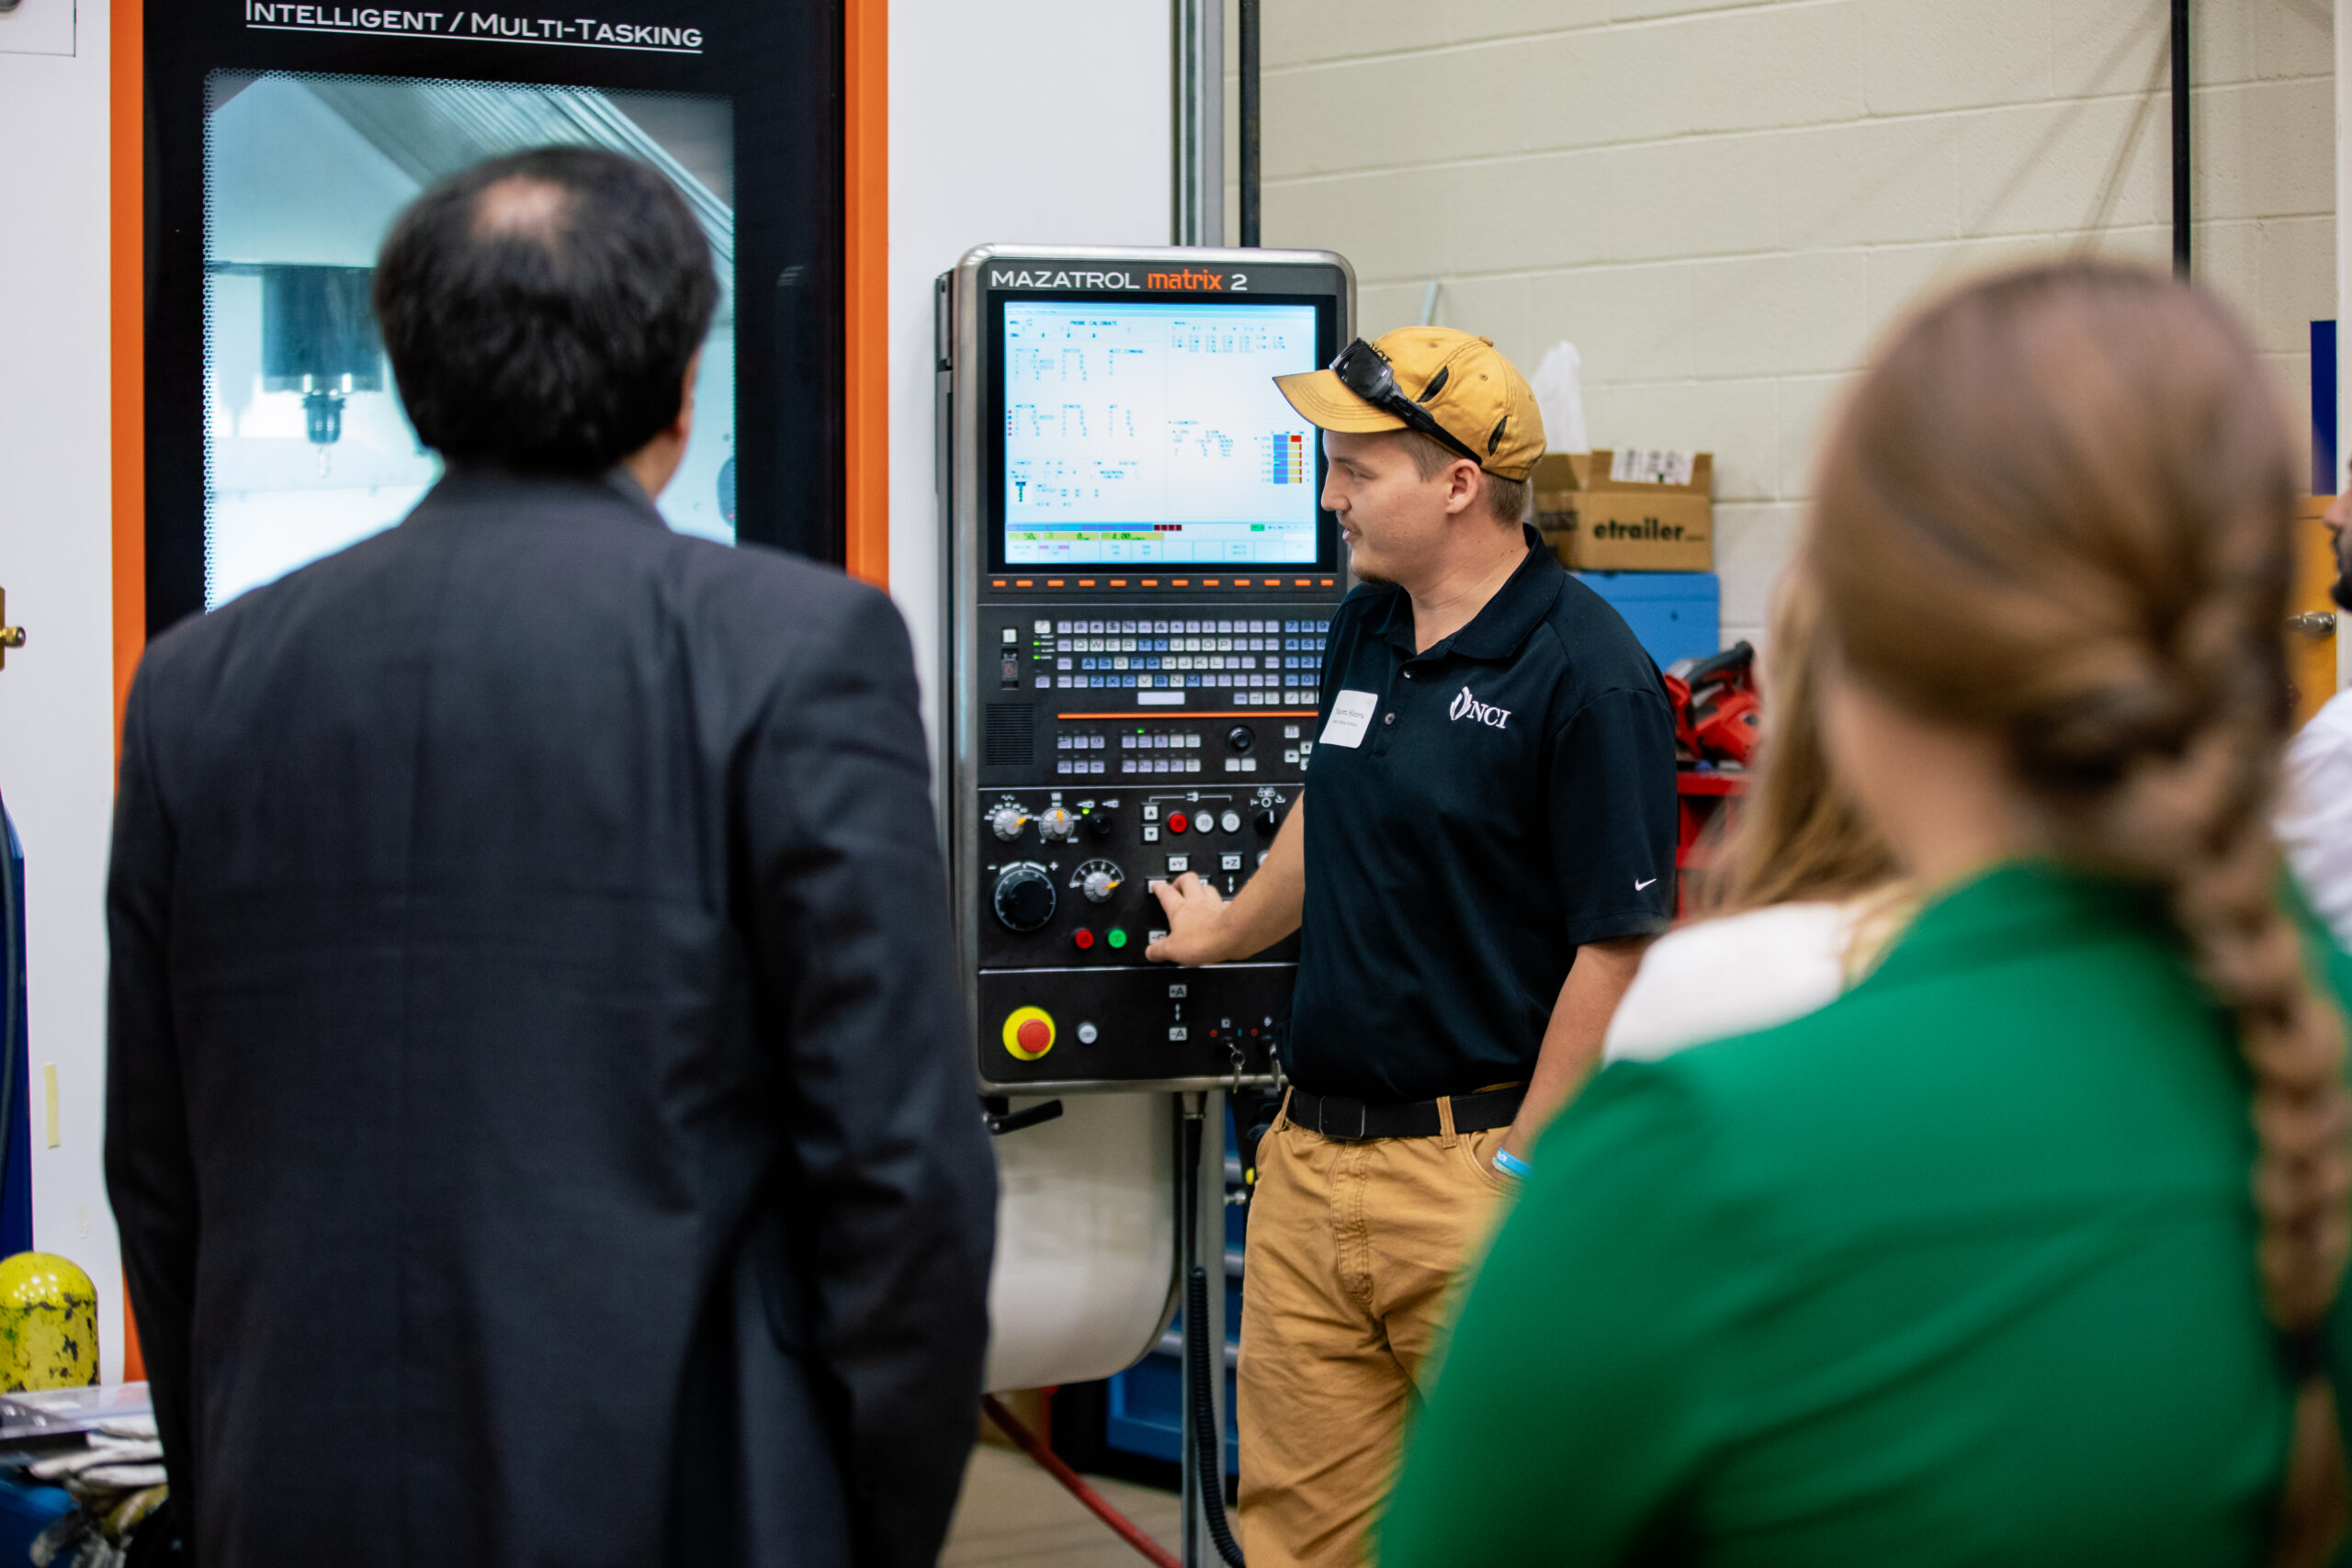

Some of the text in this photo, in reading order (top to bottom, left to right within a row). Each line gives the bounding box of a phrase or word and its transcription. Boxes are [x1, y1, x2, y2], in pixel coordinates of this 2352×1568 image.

[246, 0, 703, 47] INTELLIGENT / MULTI-TASKING
[991, 268, 1249, 291] MAZATROL matrix 2
[1593, 517, 1684, 541] etrailer
[1466, 700, 1511, 728] NCI
